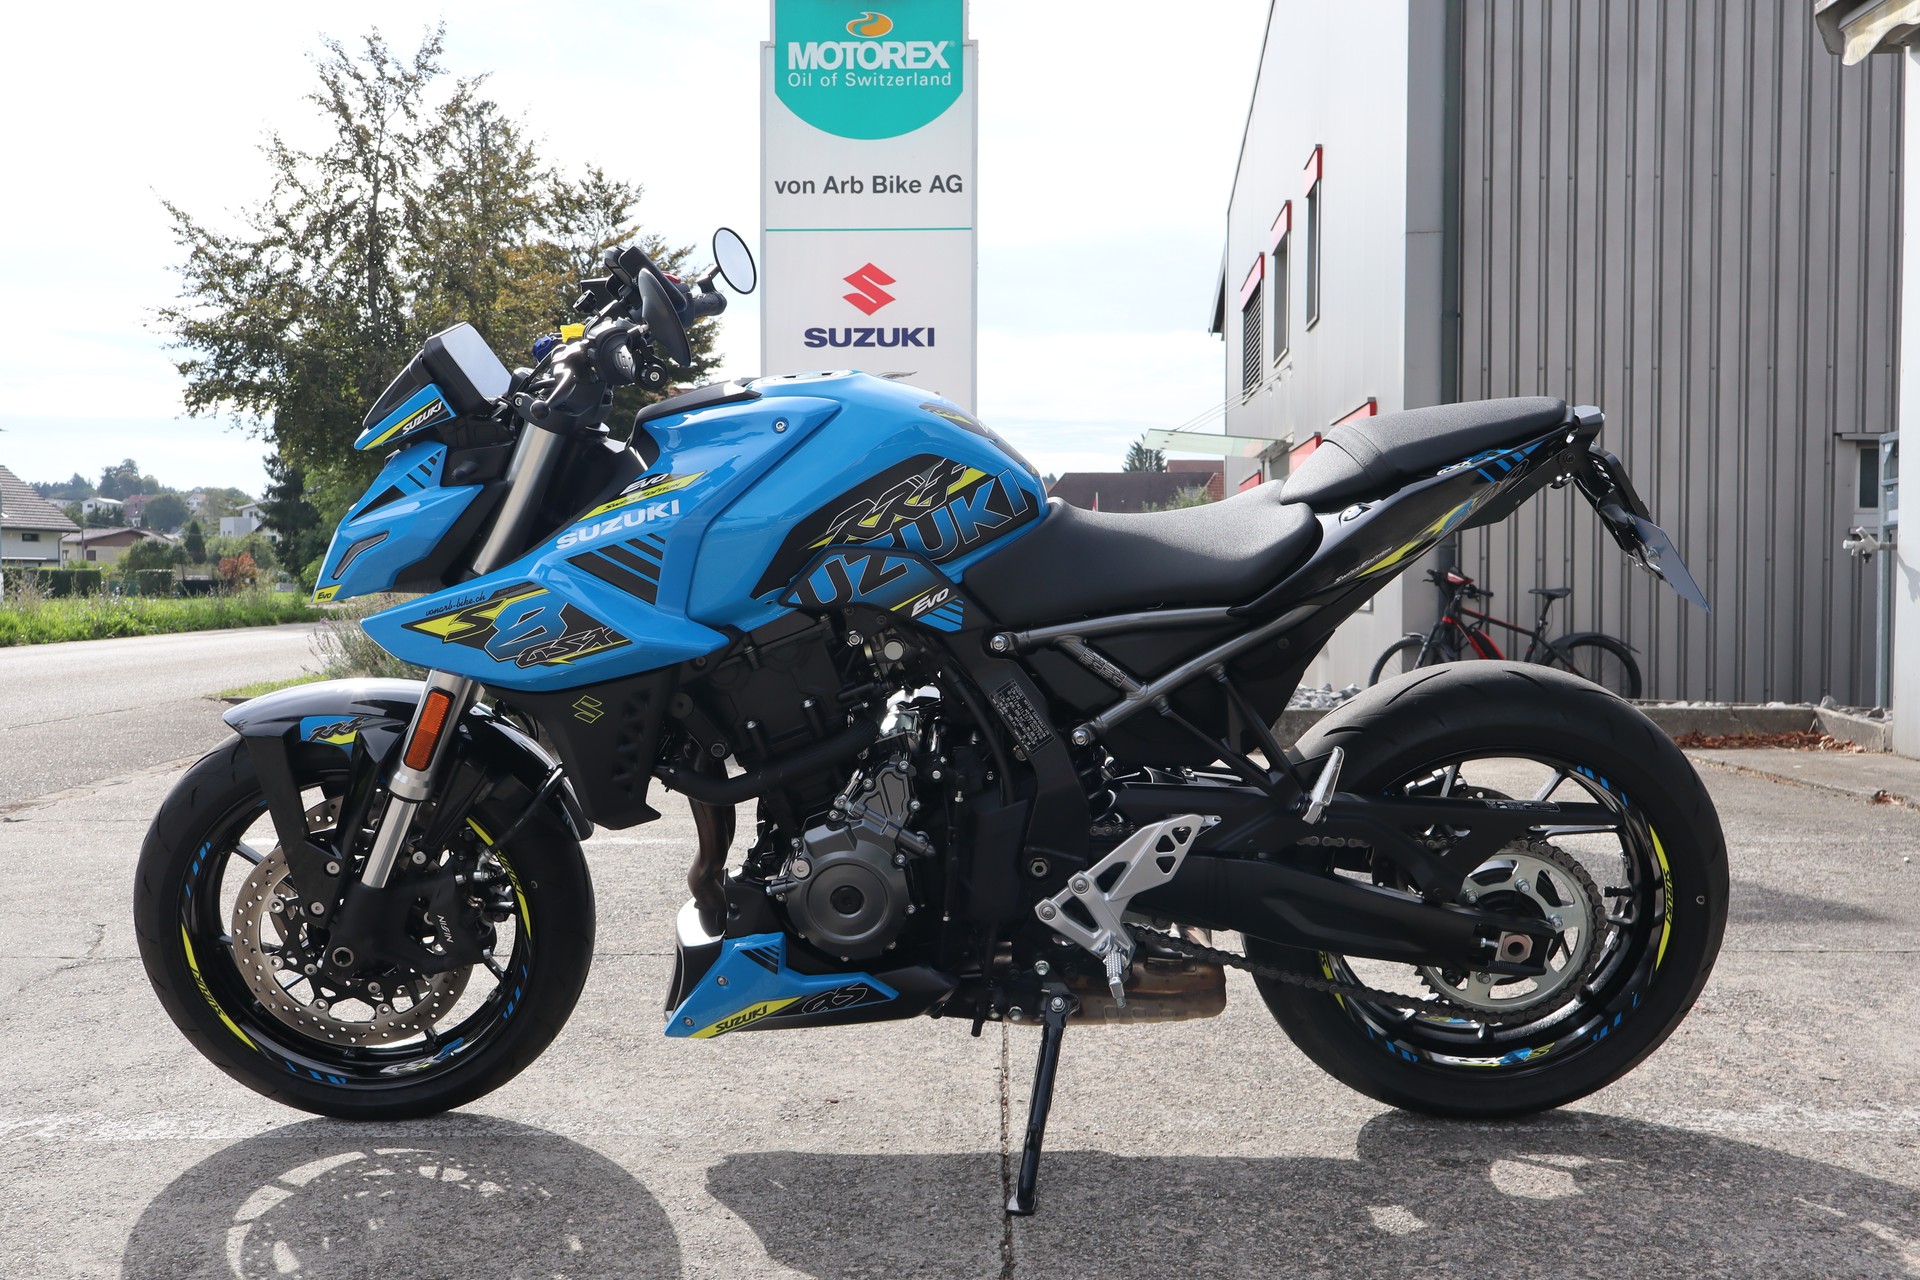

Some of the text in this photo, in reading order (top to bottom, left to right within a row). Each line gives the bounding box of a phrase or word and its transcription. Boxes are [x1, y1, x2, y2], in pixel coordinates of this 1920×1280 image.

[788, 40, 950, 70] MOTOREX
[788, 71, 952, 87] Oil of Switzerland
[774, 174, 963, 194] von Arb Bike AG
[804, 327, 935, 348] SUZUKI
[402, 401, 443, 436] SUZUKI
[822, 457, 968, 552] スズキ
[556, 499, 680, 550] SUZUKI
[756, 468, 1028, 604] UZUKI
[425, 590, 487, 617] vonarb-bike.ch
[307, 715, 365, 742] スズキ
[1662, 867, 1674, 927] SUZUKI
[715, 1004, 768, 1033] SUZUKI
